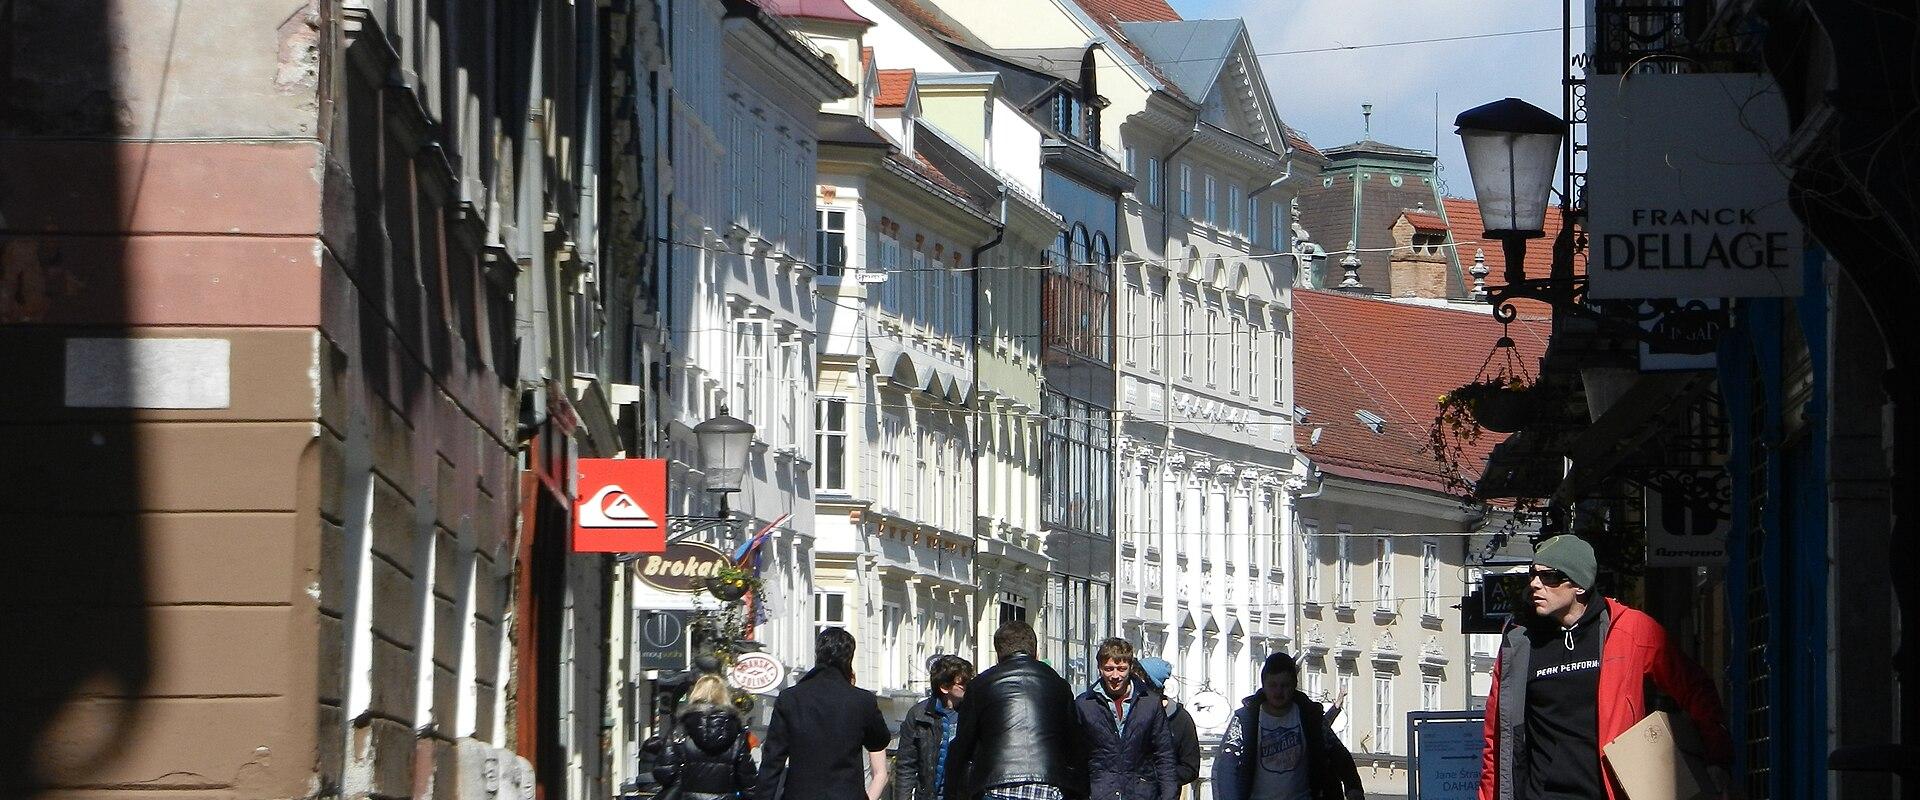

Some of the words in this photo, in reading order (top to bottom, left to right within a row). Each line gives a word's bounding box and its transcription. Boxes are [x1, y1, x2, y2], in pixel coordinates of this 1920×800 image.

[1632, 208, 1756, 225] FRANCK
[1603, 232, 1789, 271] DELLAGE
[643, 555, 724, 578] Brokat
[1536, 665, 1559, 678] PEAK
[1560, 660, 1600, 673] PERFORM
